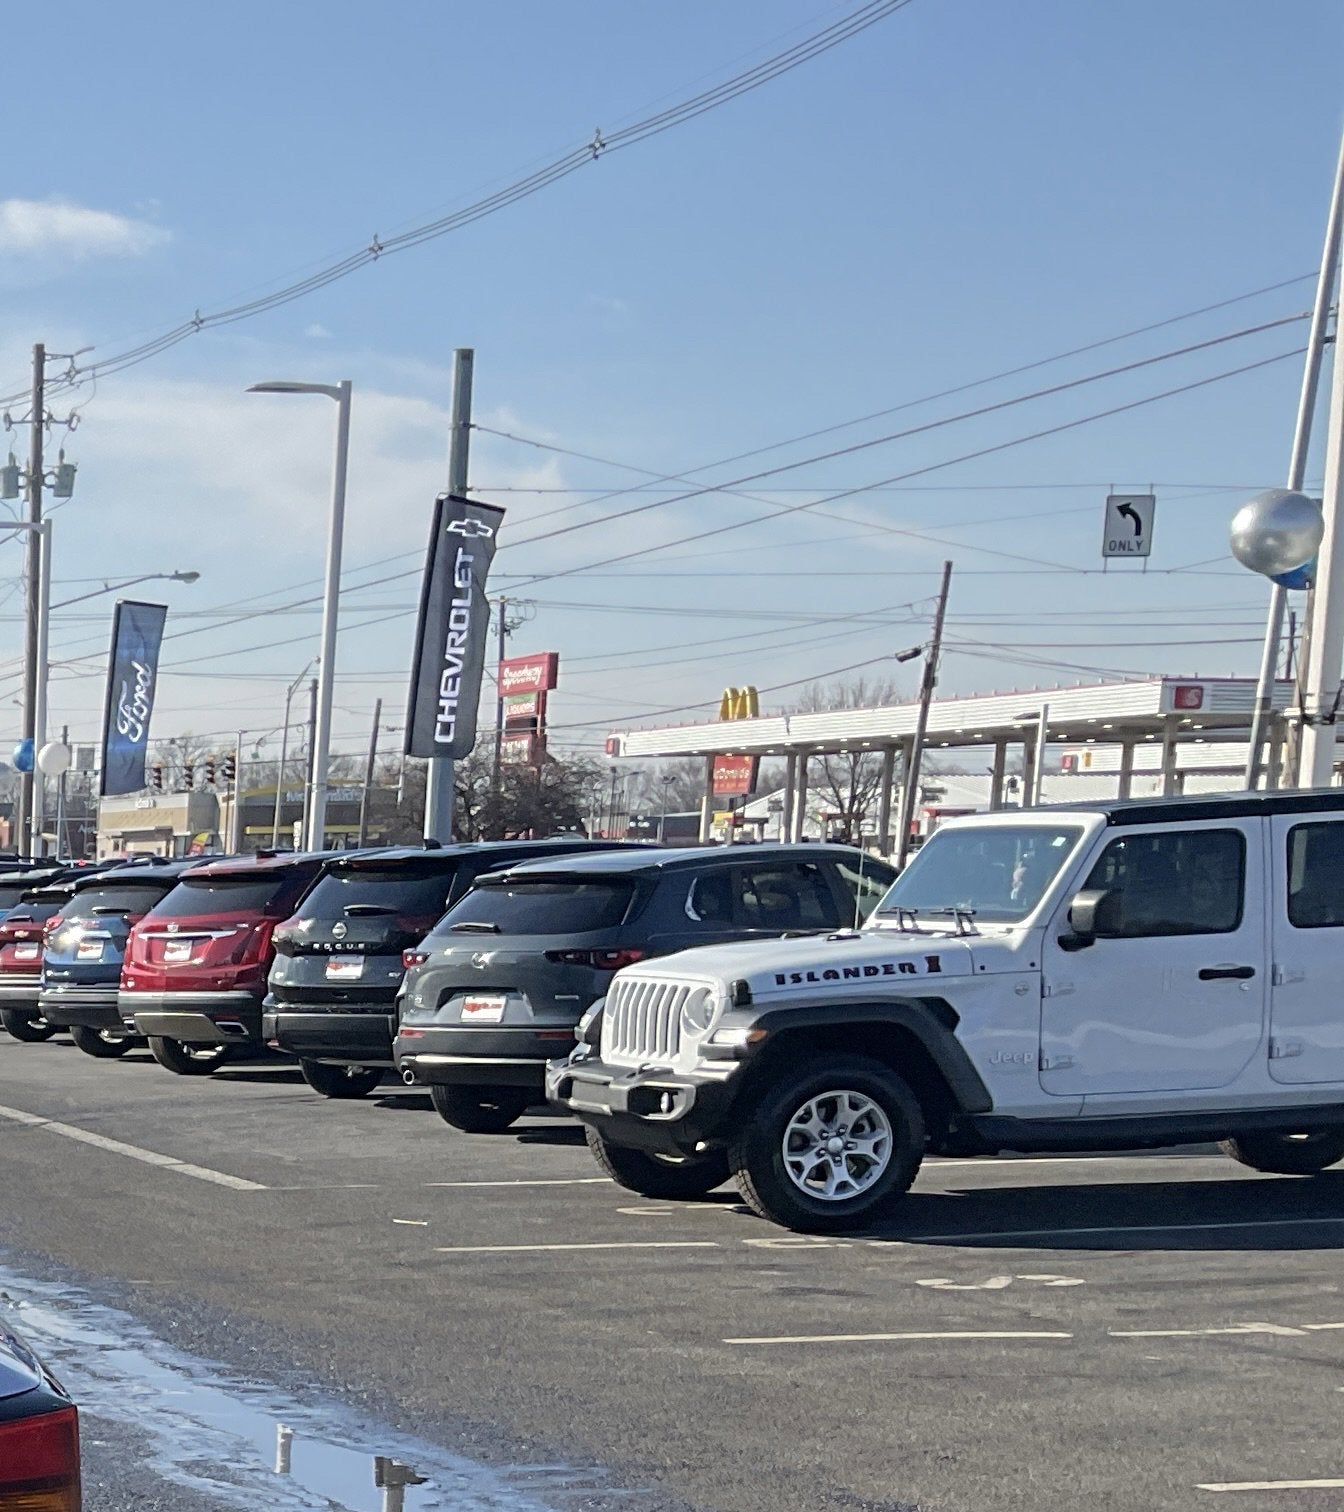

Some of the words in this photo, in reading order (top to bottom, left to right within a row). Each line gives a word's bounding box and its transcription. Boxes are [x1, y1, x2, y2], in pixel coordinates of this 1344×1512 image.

[1109, 540, 1143, 551] ONLY
[434, 547, 474, 743] CHEVROLET
[117, 661, 152, 742] Ford
[775, 961, 918, 985] ISLANDER
[989, 1051, 1033, 1065] Jeep
